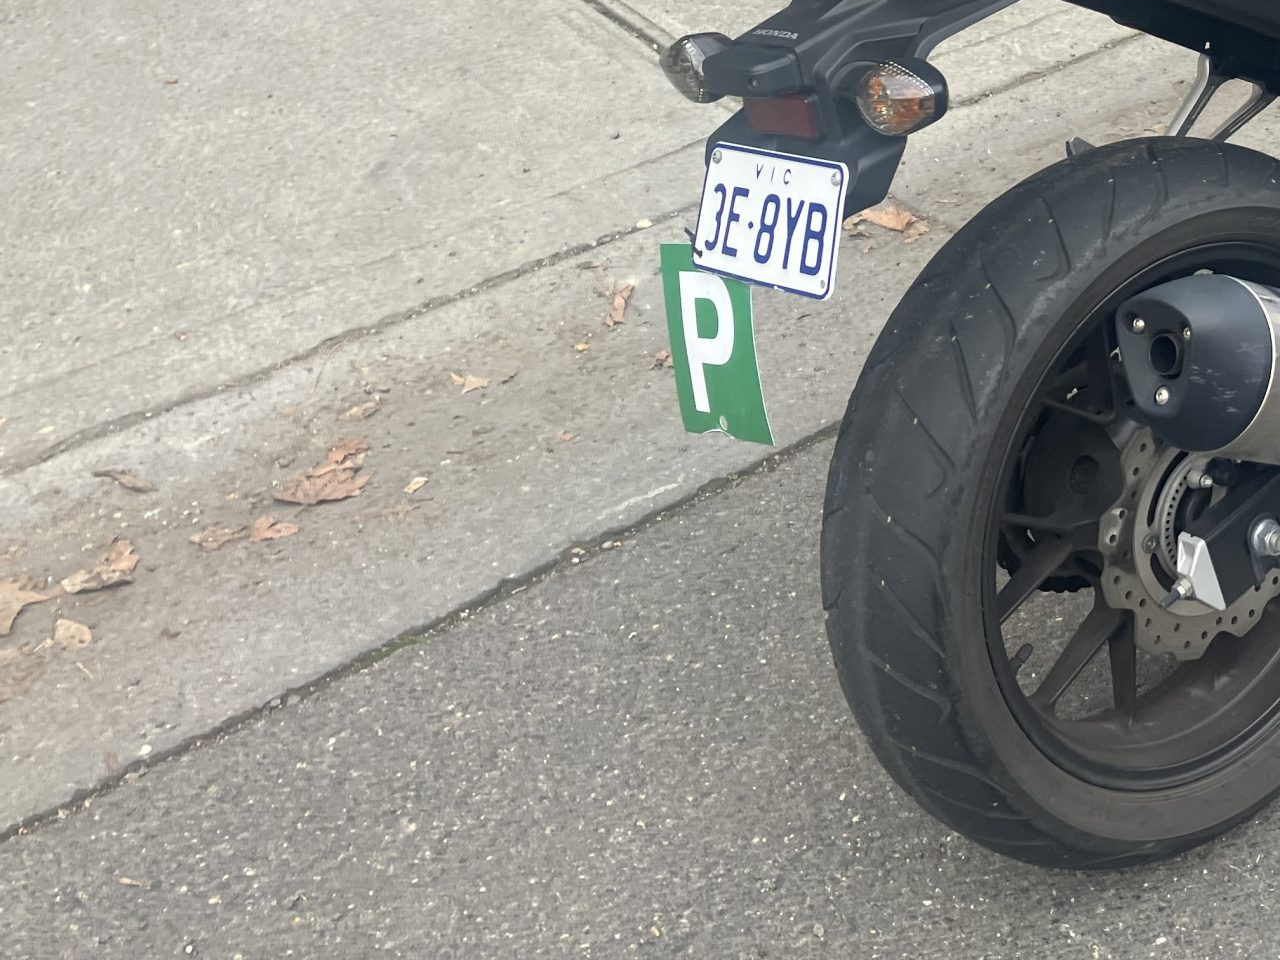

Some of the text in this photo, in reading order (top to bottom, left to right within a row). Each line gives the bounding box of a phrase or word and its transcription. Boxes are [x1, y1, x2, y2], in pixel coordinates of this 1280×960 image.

[752, 29, 799, 40] HONDA
[755, 163, 792, 185] VIC
[679, 271, 735, 413] P
